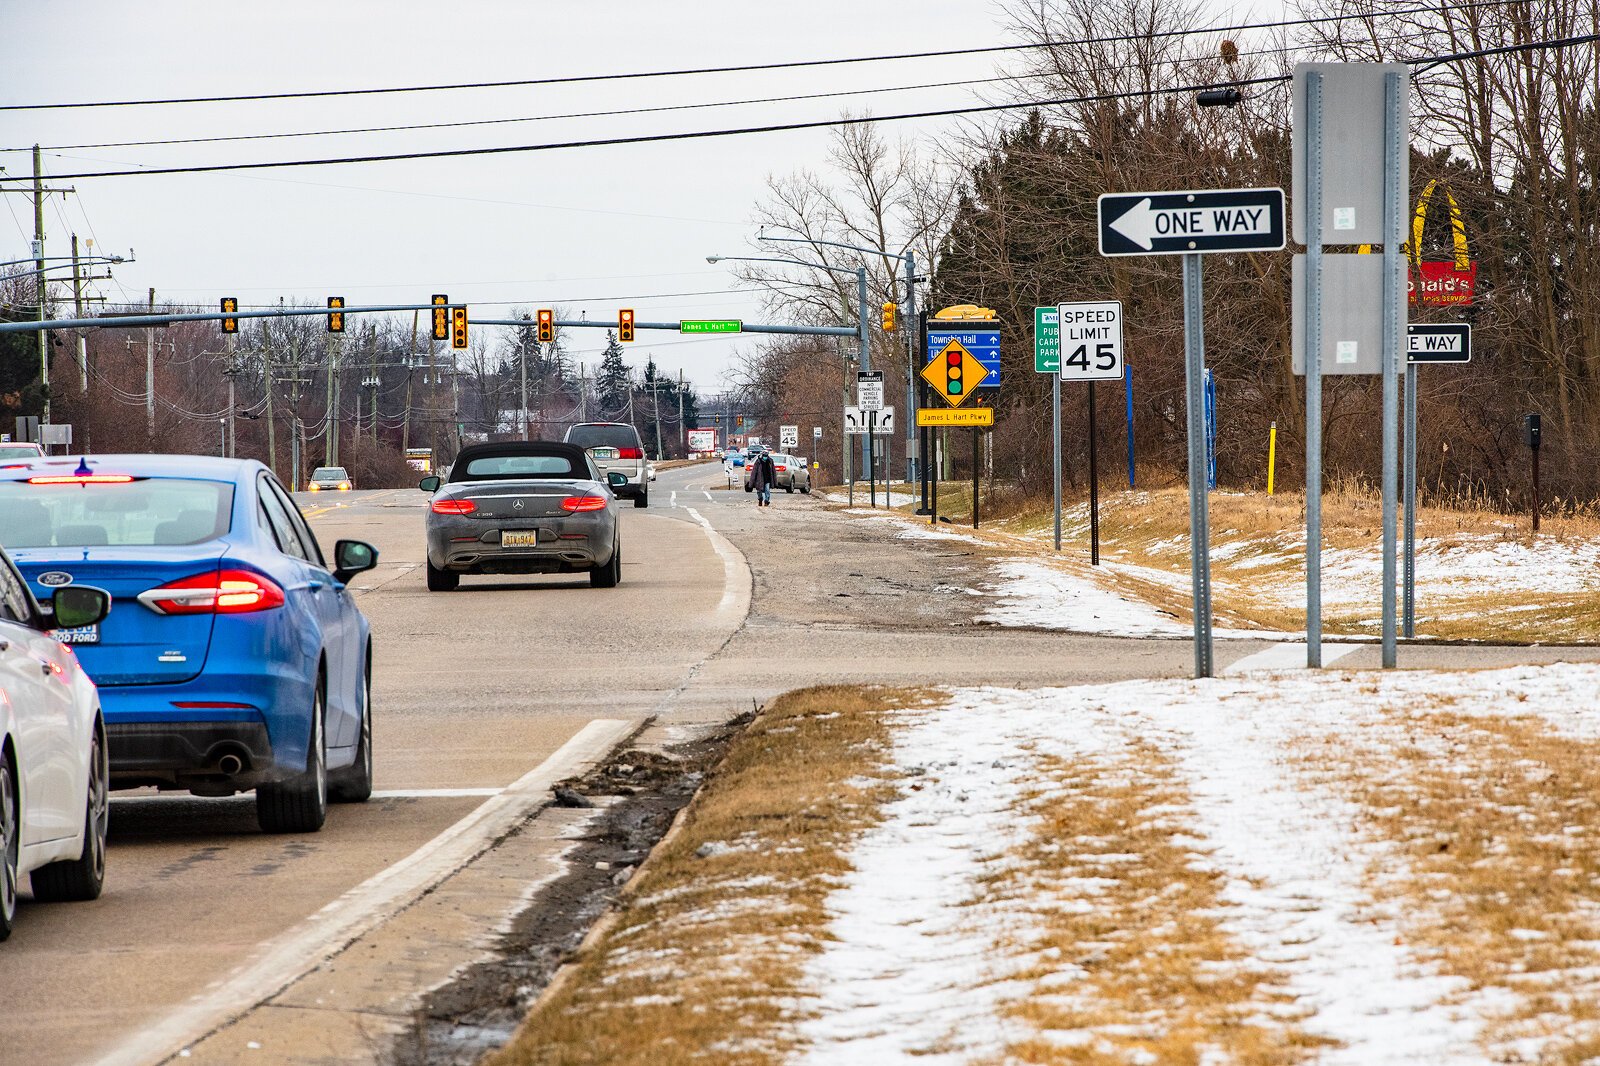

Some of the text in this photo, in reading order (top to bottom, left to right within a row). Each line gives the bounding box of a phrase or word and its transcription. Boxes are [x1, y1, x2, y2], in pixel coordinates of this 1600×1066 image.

[1155, 208, 1263, 235] ONE WAY
[1065, 311, 1115, 323] SPEED
[1043, 328, 1059, 336] PUB
[1070, 327, 1111, 340] LIMIT
[963, 334, 977, 344] Hall
[1038, 338, 1059, 346] CARP
[1425, 337, 1457, 350] WAY
[1066, 344, 1116, 371] 45
[782, 437, 796, 445] 45
[72, 633, 97, 643] FORD
